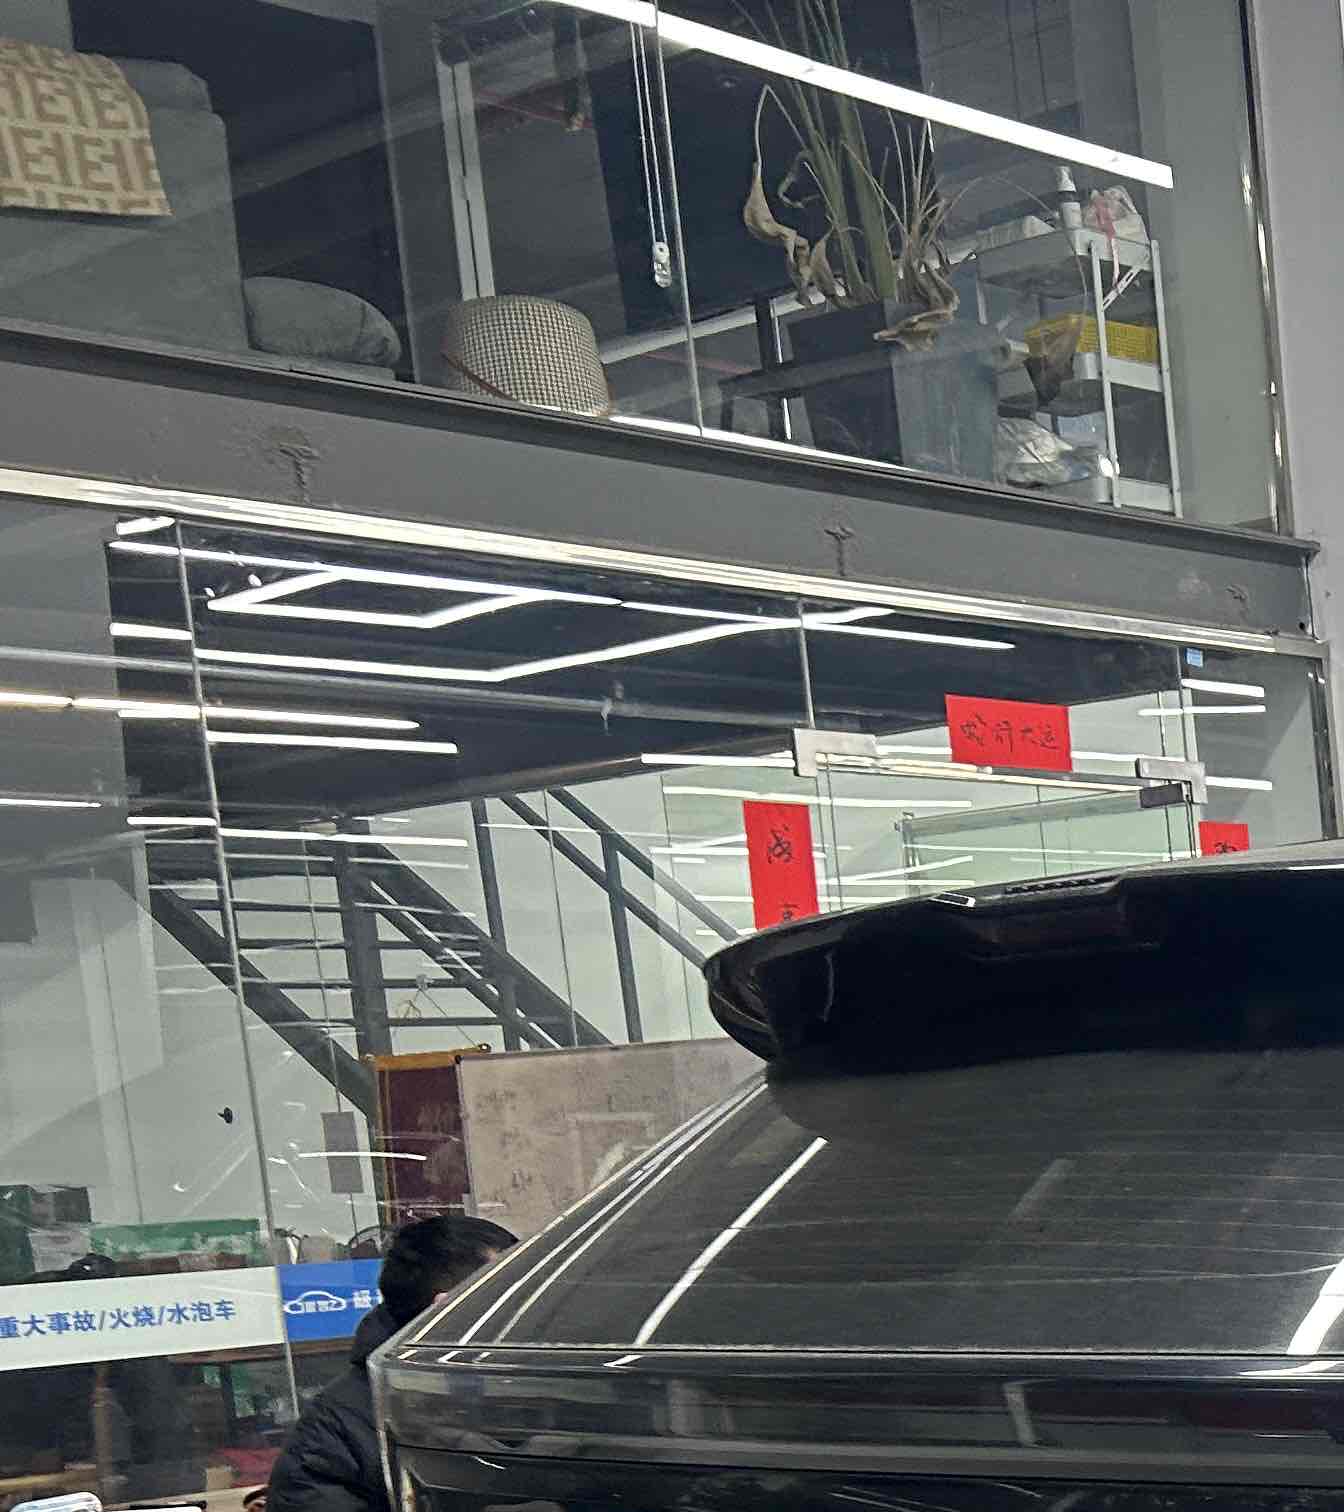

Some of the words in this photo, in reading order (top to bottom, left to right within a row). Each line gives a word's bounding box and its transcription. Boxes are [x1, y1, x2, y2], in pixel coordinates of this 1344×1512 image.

[0, 1300, 236, 1339] 重大事故/火烧/水泡车
